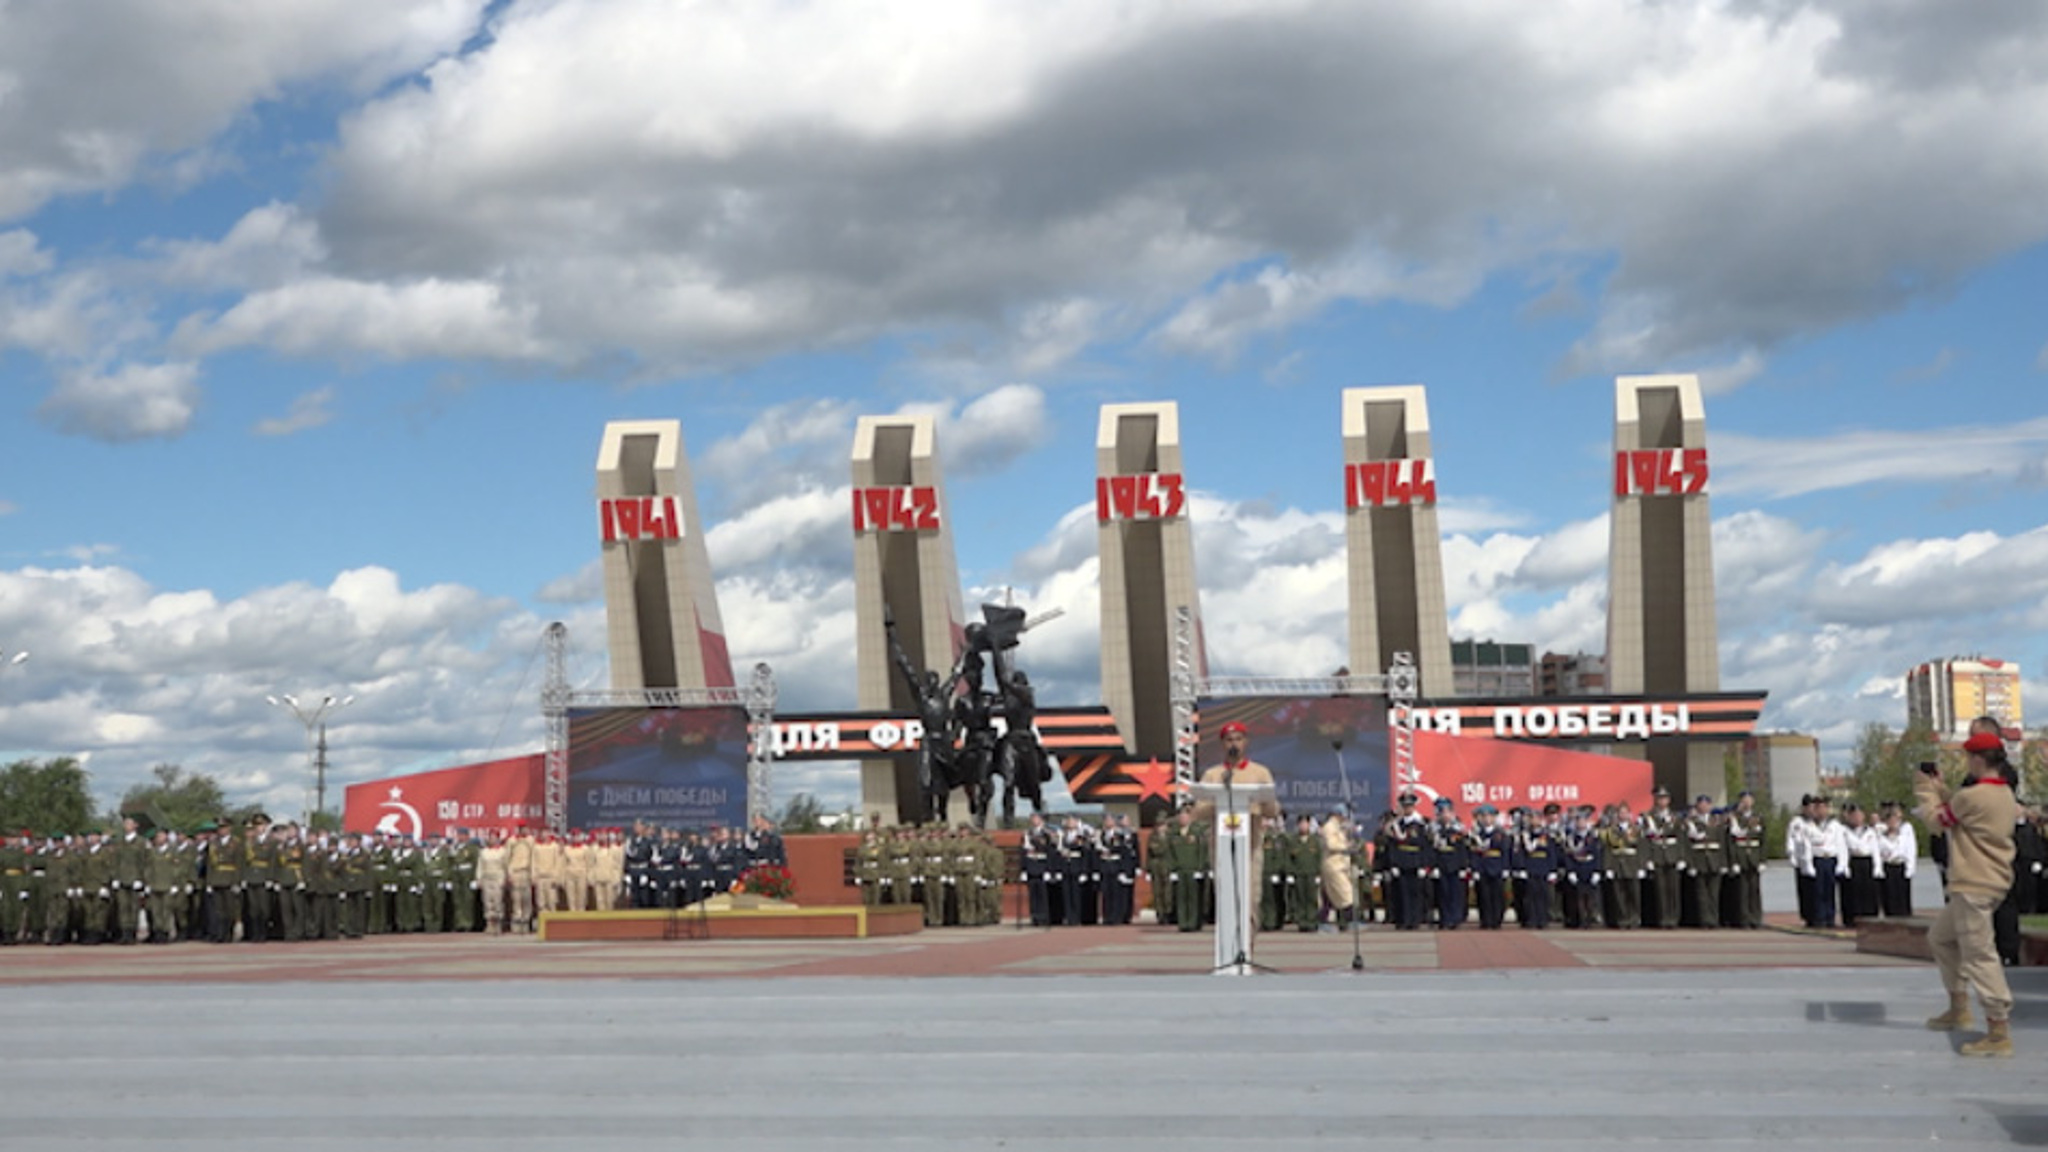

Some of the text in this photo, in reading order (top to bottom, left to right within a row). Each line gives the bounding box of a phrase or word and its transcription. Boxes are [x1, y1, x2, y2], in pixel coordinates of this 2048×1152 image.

[1345, 458, 1437, 508] 1944
[1616, 448, 1709, 496] 1945
[600, 496, 682, 541] 1941
[852, 486, 940, 532] 1942
[1096, 473, 1185, 520] 1943
[1493, 702, 1691, 740] ПОБЕДЫ
[655, 786, 727, 806] ПОБЕДЫ
[1461, 782, 1485, 802] 150
